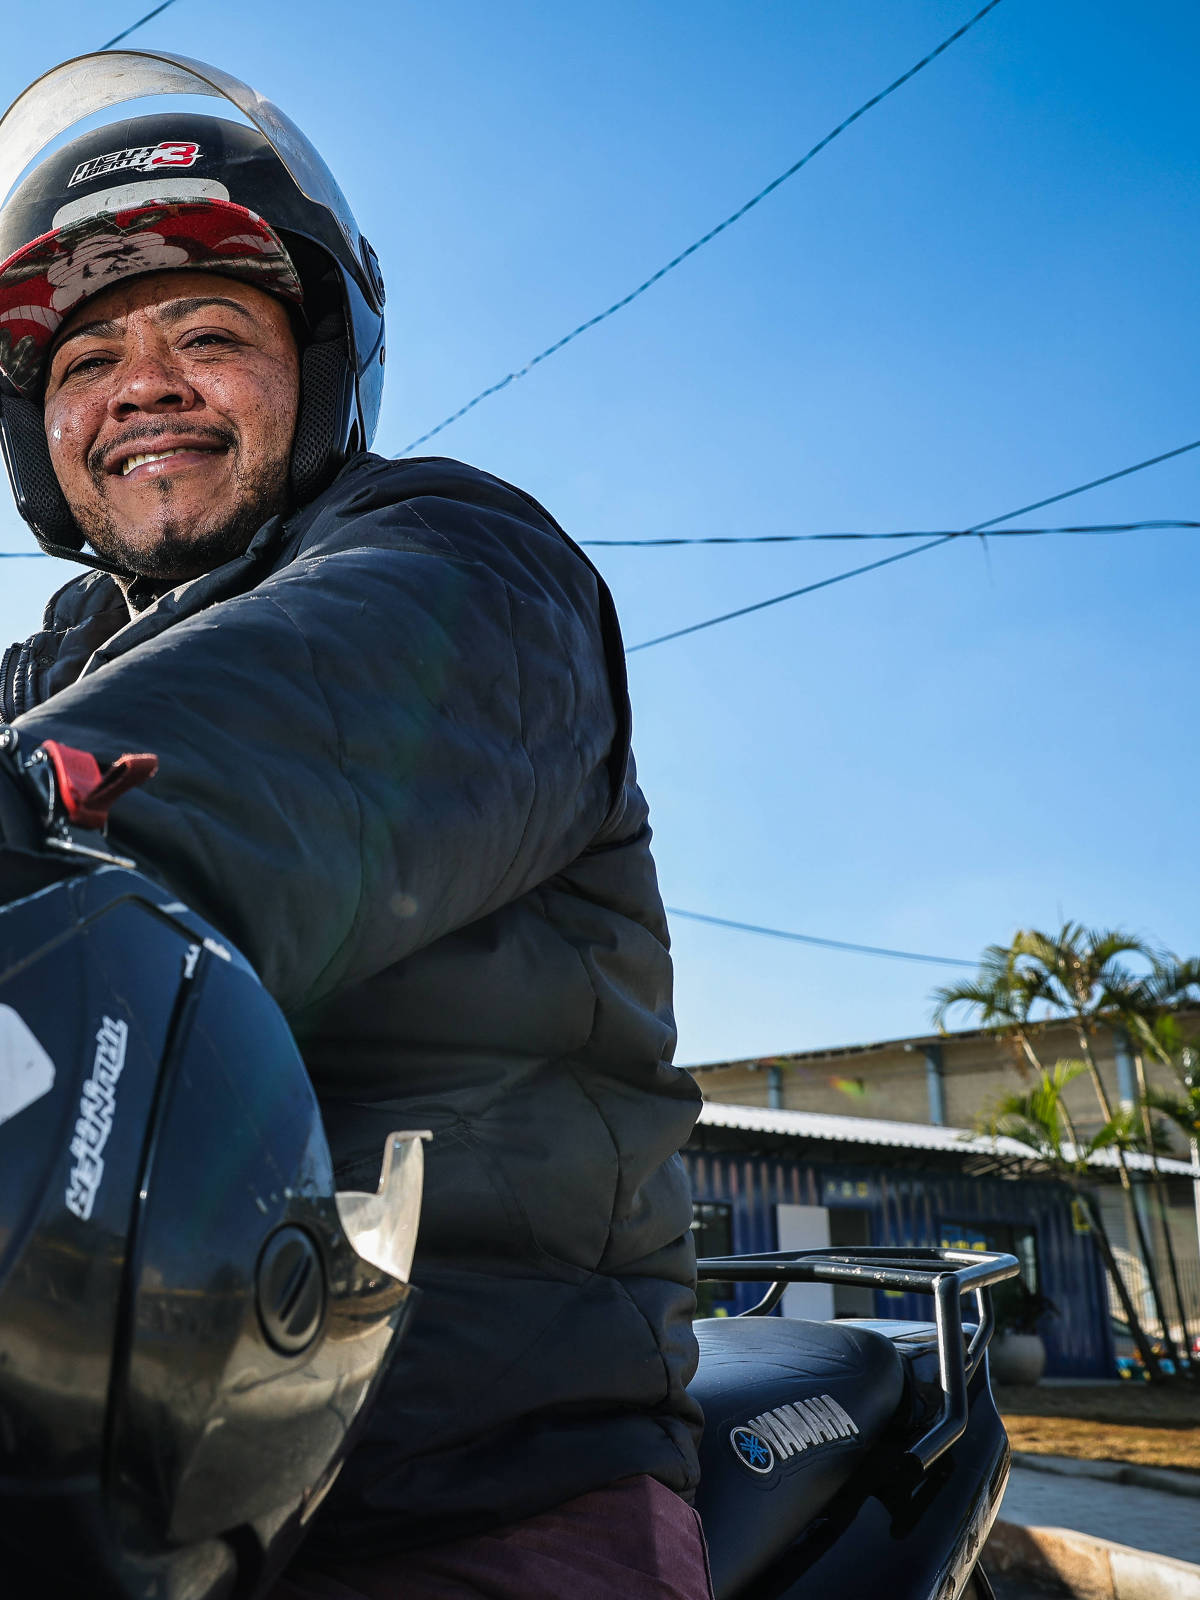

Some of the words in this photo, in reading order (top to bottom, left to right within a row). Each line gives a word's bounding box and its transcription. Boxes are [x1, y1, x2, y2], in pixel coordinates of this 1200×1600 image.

[150, 141, 199, 168] 3
[65, 1015, 128, 1221] THUNDER
[748, 1394, 860, 1460] YAMAHA
